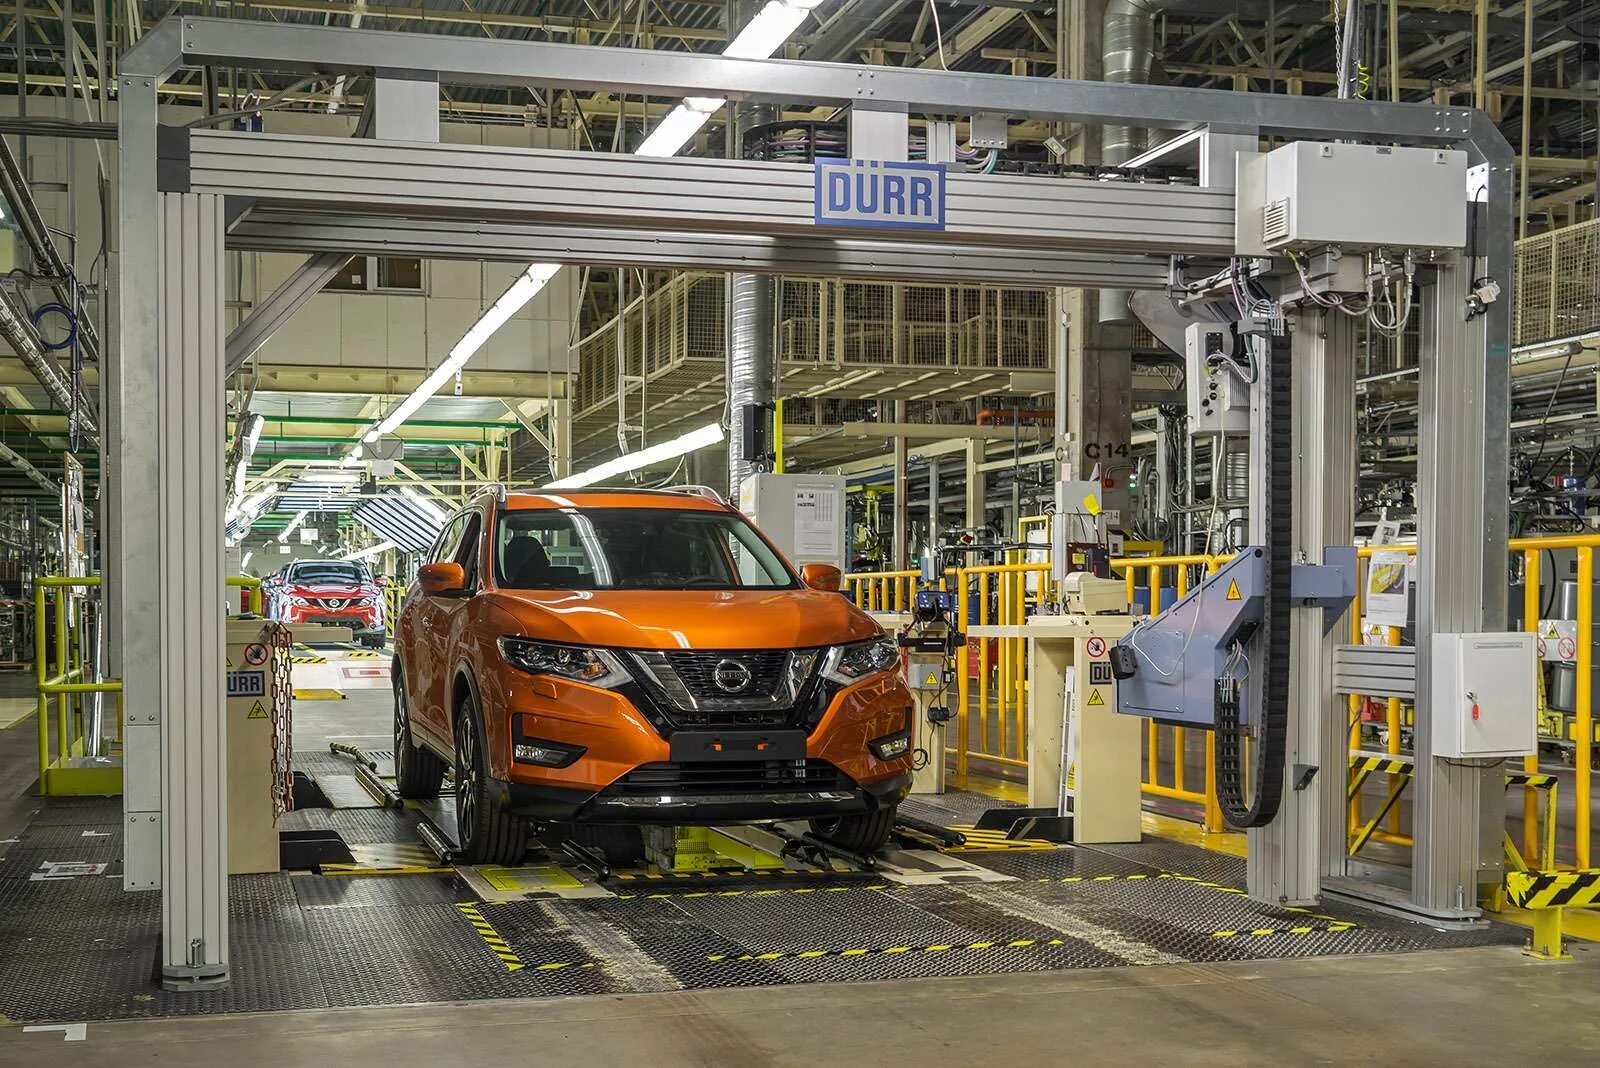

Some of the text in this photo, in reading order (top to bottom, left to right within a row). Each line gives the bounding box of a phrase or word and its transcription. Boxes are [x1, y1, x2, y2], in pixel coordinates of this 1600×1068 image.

[829, 160, 932, 216] DÜRR
[1094, 662, 1111, 680] DÜ
[227, 672, 260, 692] ÜRR
